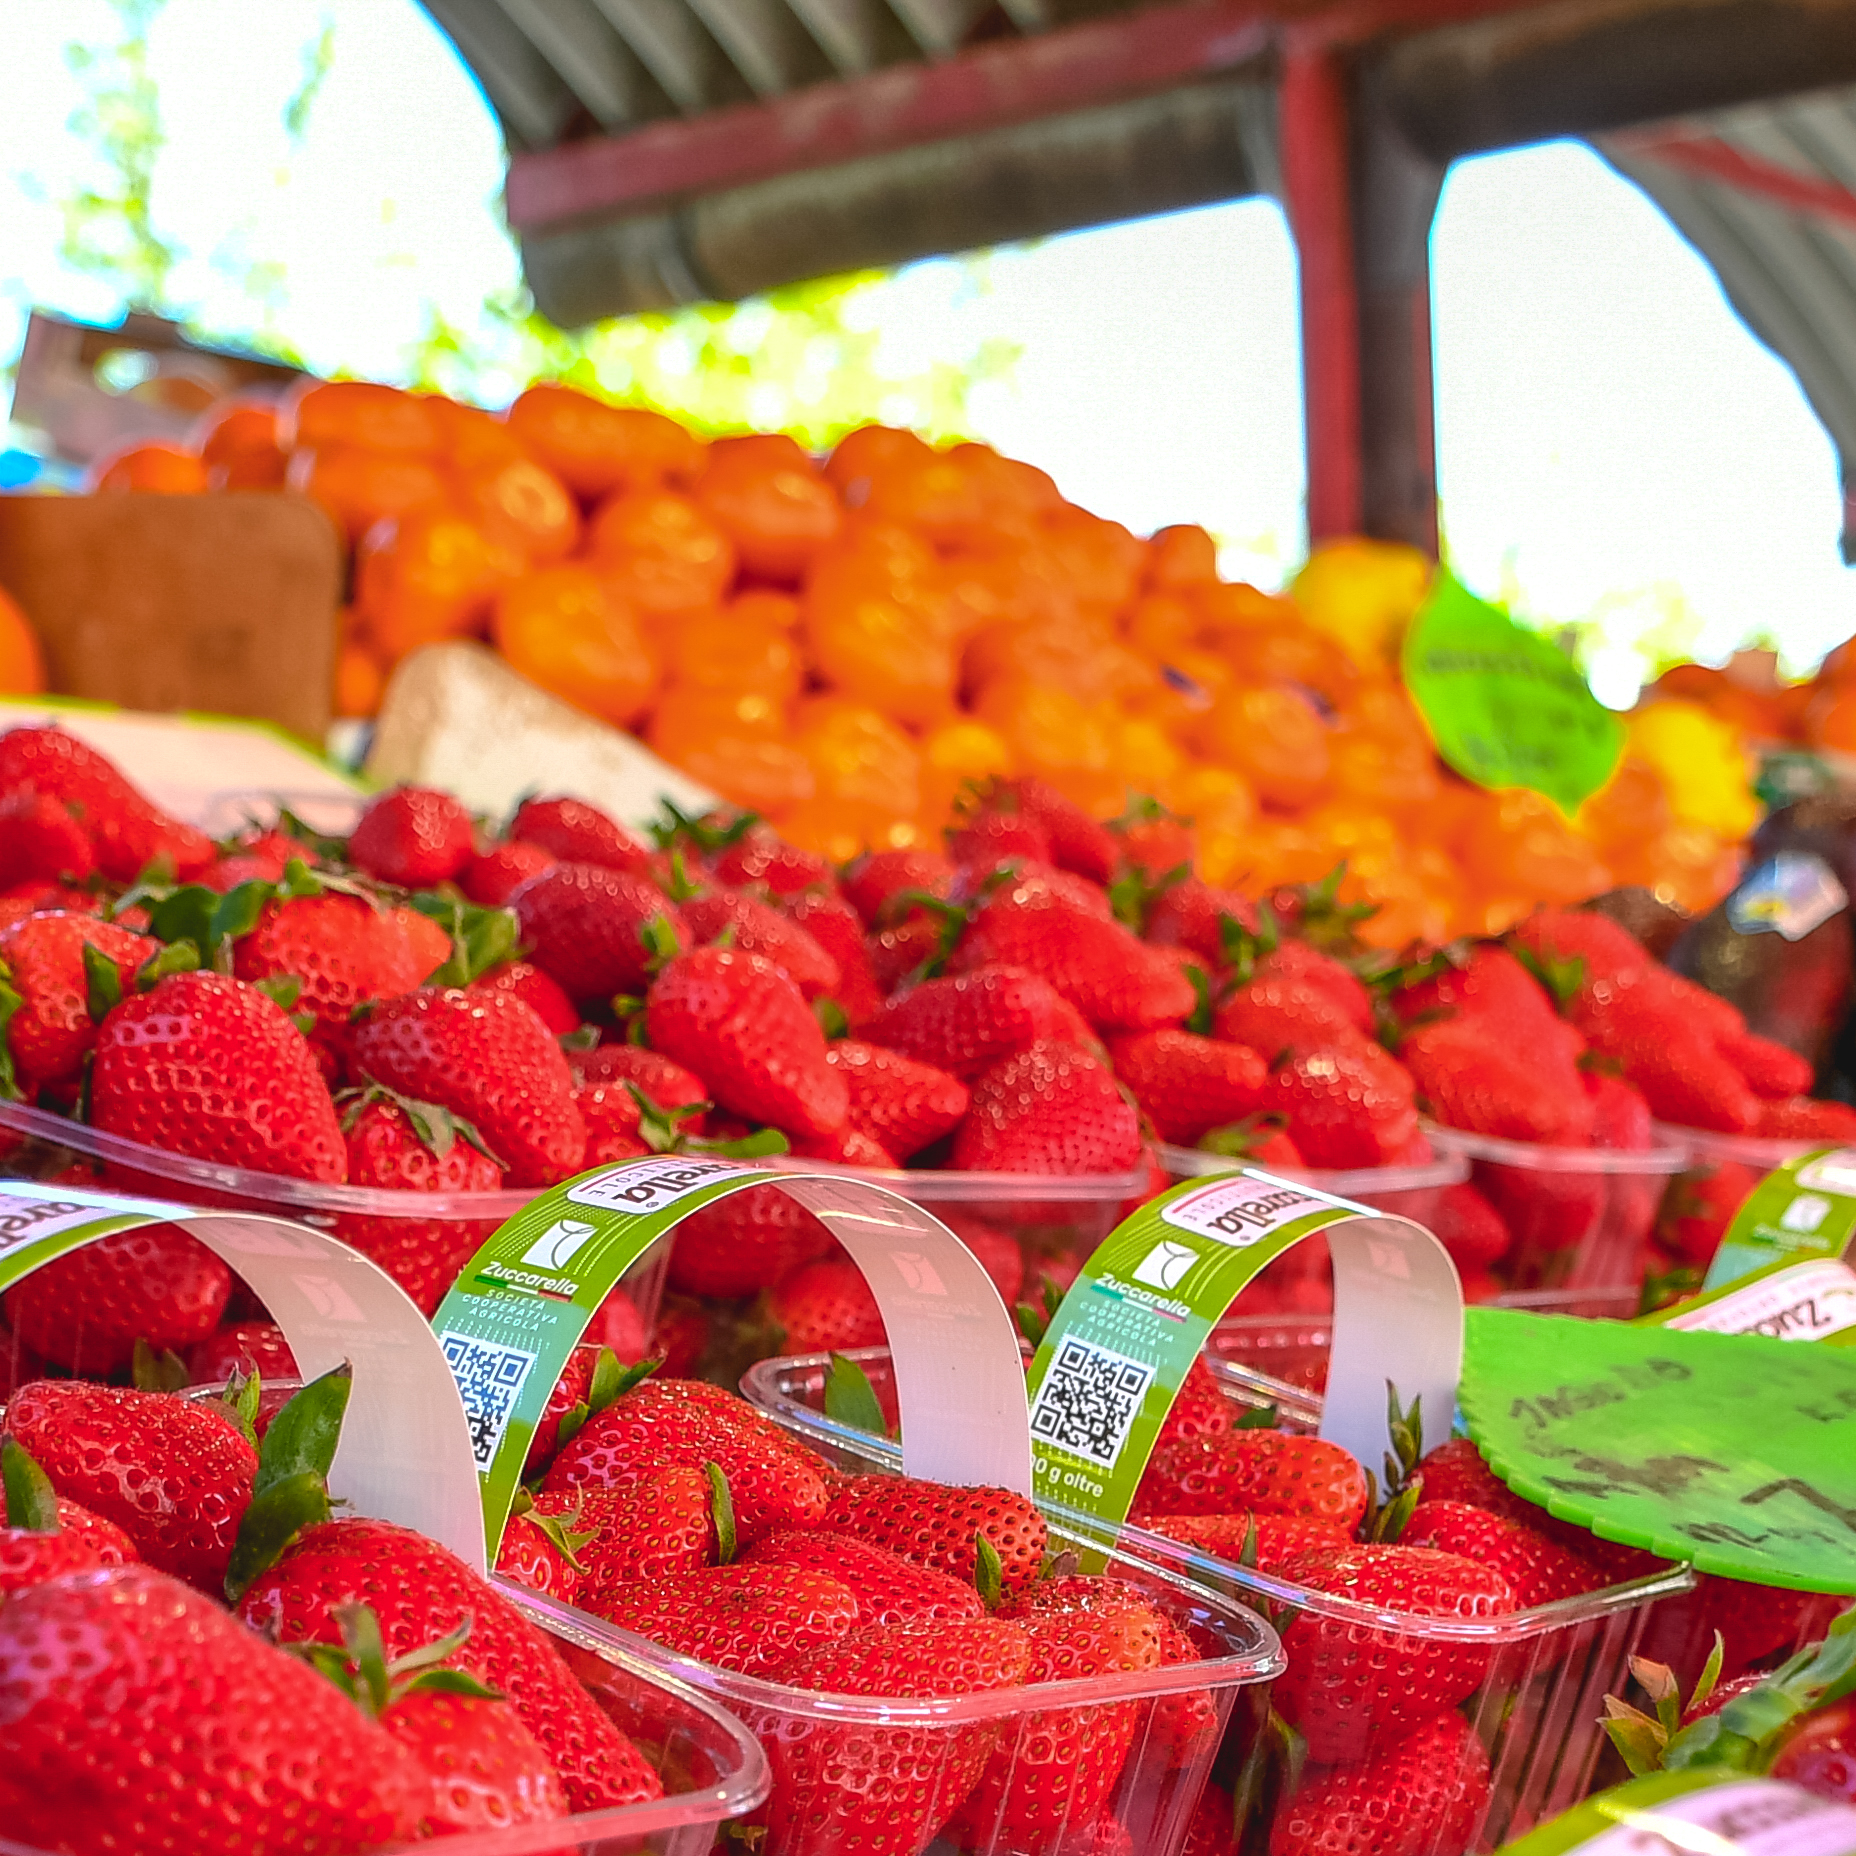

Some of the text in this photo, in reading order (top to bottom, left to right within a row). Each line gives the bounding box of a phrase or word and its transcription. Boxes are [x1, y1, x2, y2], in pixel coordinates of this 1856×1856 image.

[480, 1260, 579, 1296] Zuccarella
[1096, 1271, 1192, 1318] Zuccarella
[461, 1293, 559, 1326] COOPERATIVA
[468, 1305, 541, 1333] AGRICOLA
[1048, 1463, 1061, 1486] g
[1062, 1467, 1104, 1498] oltre
